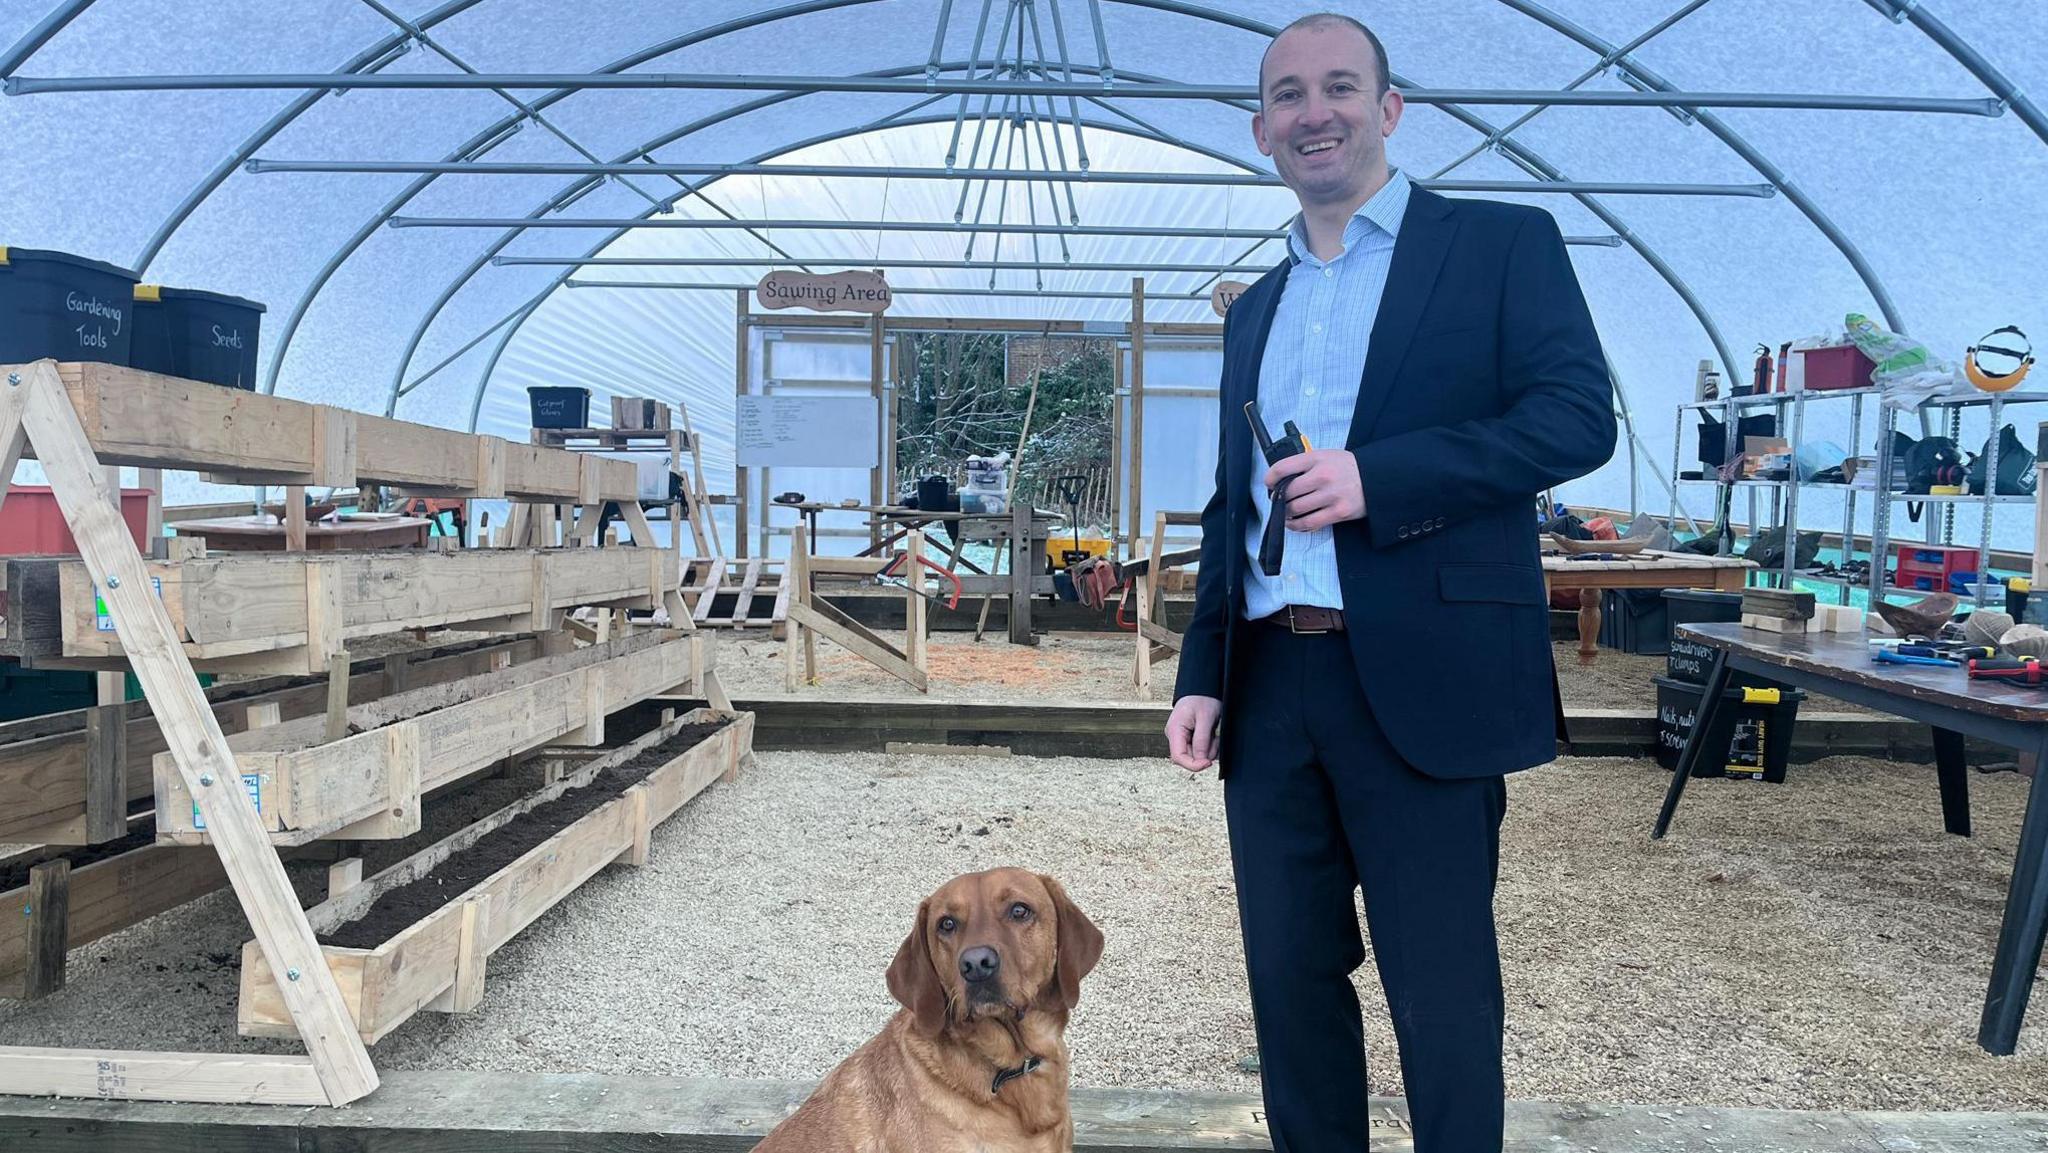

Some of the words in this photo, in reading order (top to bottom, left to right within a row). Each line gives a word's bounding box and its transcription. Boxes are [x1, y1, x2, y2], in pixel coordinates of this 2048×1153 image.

[766, 281, 836, 304] Sawing
[842, 284, 887, 301] Area
[1219, 292, 1242, 308] W
[66, 291, 122, 336] Gardening
[76, 324, 108, 349] Tools
[212, 324, 243, 350] Seeds
[1665, 732, 1689, 750] screw
